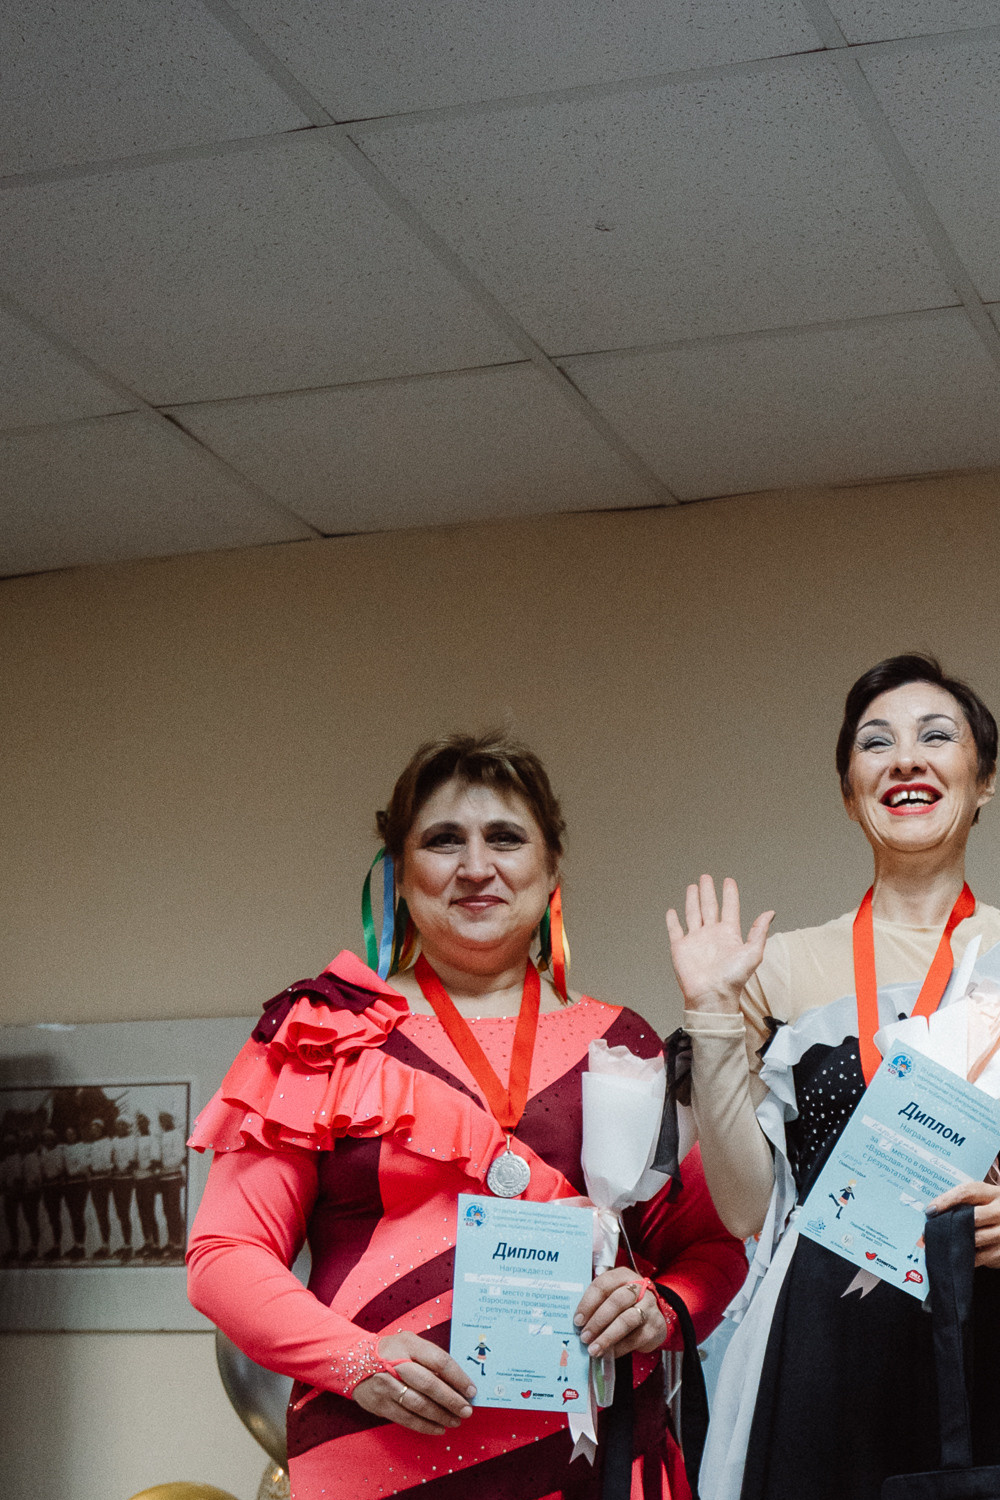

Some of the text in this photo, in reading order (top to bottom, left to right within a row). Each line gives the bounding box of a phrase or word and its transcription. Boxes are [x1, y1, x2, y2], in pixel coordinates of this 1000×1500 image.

[898, 1101, 966, 1147] Диплом
[899, 1123, 951, 1157] Награждается
[891, 1148, 912, 1163] место
[492, 1242, 560, 1263] Диплом
[499, 1265, 552, 1276] Награждается
